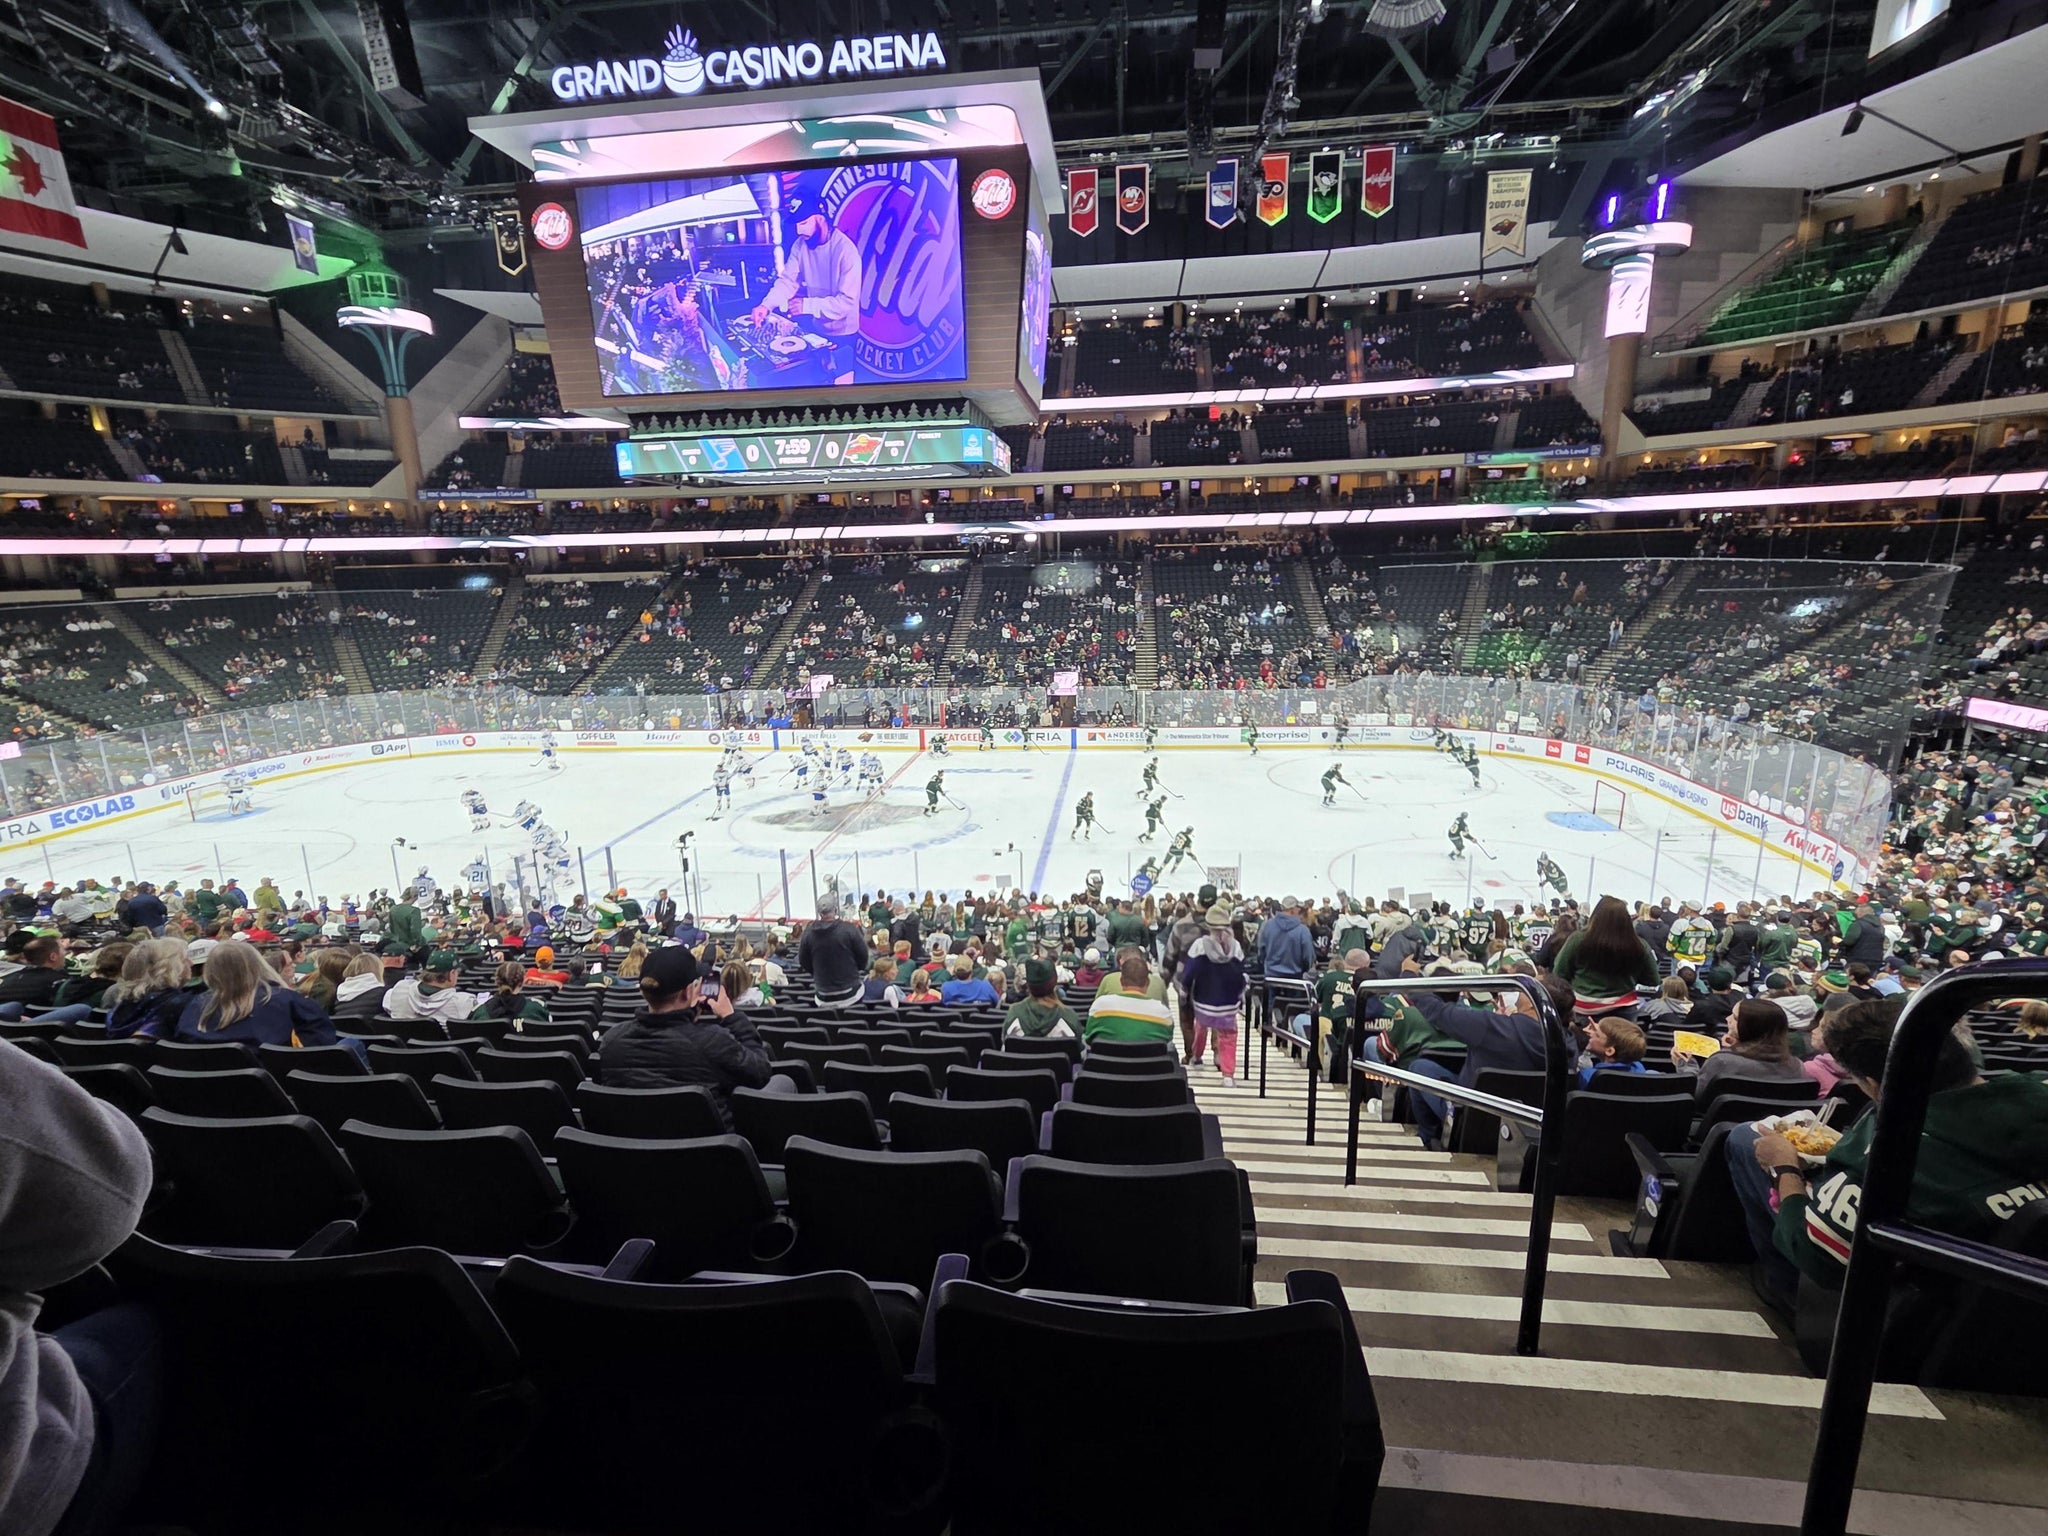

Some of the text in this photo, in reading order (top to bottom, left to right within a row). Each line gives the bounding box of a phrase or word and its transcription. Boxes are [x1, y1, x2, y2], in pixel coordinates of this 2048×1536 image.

[551, 32, 946, 100] GRAND CASINO ARENA
[1488, 199, 1526, 209] 2007-08
[914, 317, 955, 366] CLUB
[745, 444, 759, 463] 0
[775, 438, 811, 455] 7:59
[825, 441, 839, 460] 0
[1554, 448, 1569, 456] Club
[1570, 447, 1589, 455] Level
[576, 732, 616, 740] LOFFLER
[1028, 732, 1062, 742] TRIA
[1107, 732, 1148, 740] ANDERSE
[256, 762, 286, 775] CASINO
[1606, 757, 1656, 782] POLARIS
[1658, 778, 1709, 807] GRAND CASINO
[49, 794, 136, 829] ECOLAB
[1738, 804, 1769, 831] bank
[471, 871, 485, 883] 21
[1074, 920, 1089, 937] 12
[1468, 927, 1490, 945] 97
[1532, 933, 1549, 947] 97
[1687, 937, 1707, 955] 14
[1816, 1171, 1863, 1231] 46
